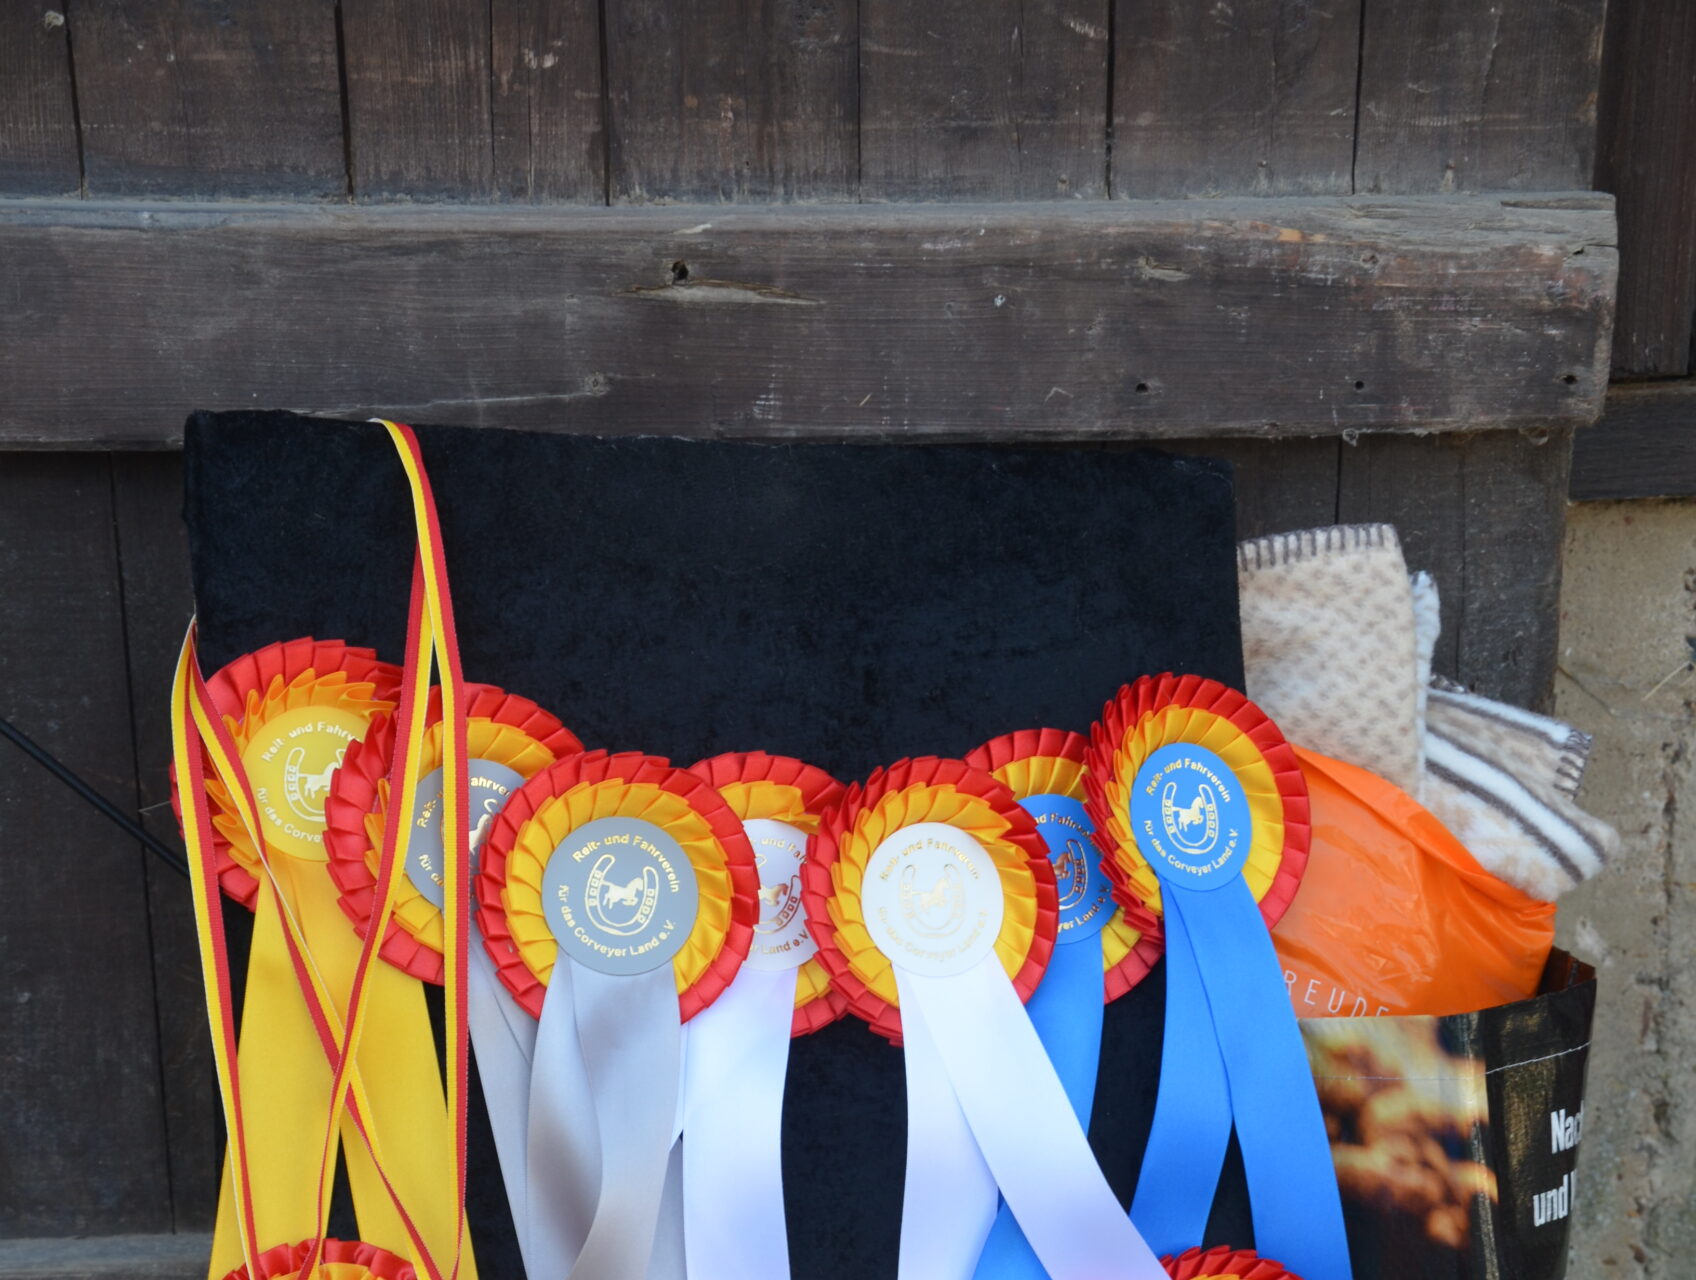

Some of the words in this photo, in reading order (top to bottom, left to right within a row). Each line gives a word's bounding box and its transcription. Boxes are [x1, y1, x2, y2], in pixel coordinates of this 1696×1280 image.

[289, 723, 312, 738] und
[317, 722, 360, 742] Fahrv
[1164, 759, 1182, 773] und
[1184, 758, 1231, 803] Fahrverein
[257, 788, 268, 804] für
[264, 807, 282, 826] das
[284, 824, 321, 843] Corve
[761, 838, 785, 848] und
[1144, 820, 1154, 836] für
[1151, 838, 1166, 858] das
[1168, 854, 1212, 876] Corveyer
[1211, 846, 1232, 869] Land
[572, 841, 601, 862] Reit-
[604, 834, 629, 845] und
[633, 836, 680, 893] Fahrverein
[902, 840, 922, 856] und
[927, 838, 979, 879] Fahrverein
[558, 885, 569, 902] für
[561, 905, 576, 927] das
[1075, 904, 1099, 927] Land
[574, 927, 626, 957] Corveyer
[630, 937, 659, 955] Land
[762, 941, 791, 954] Land
[1533, 1174, 1568, 1227] und
